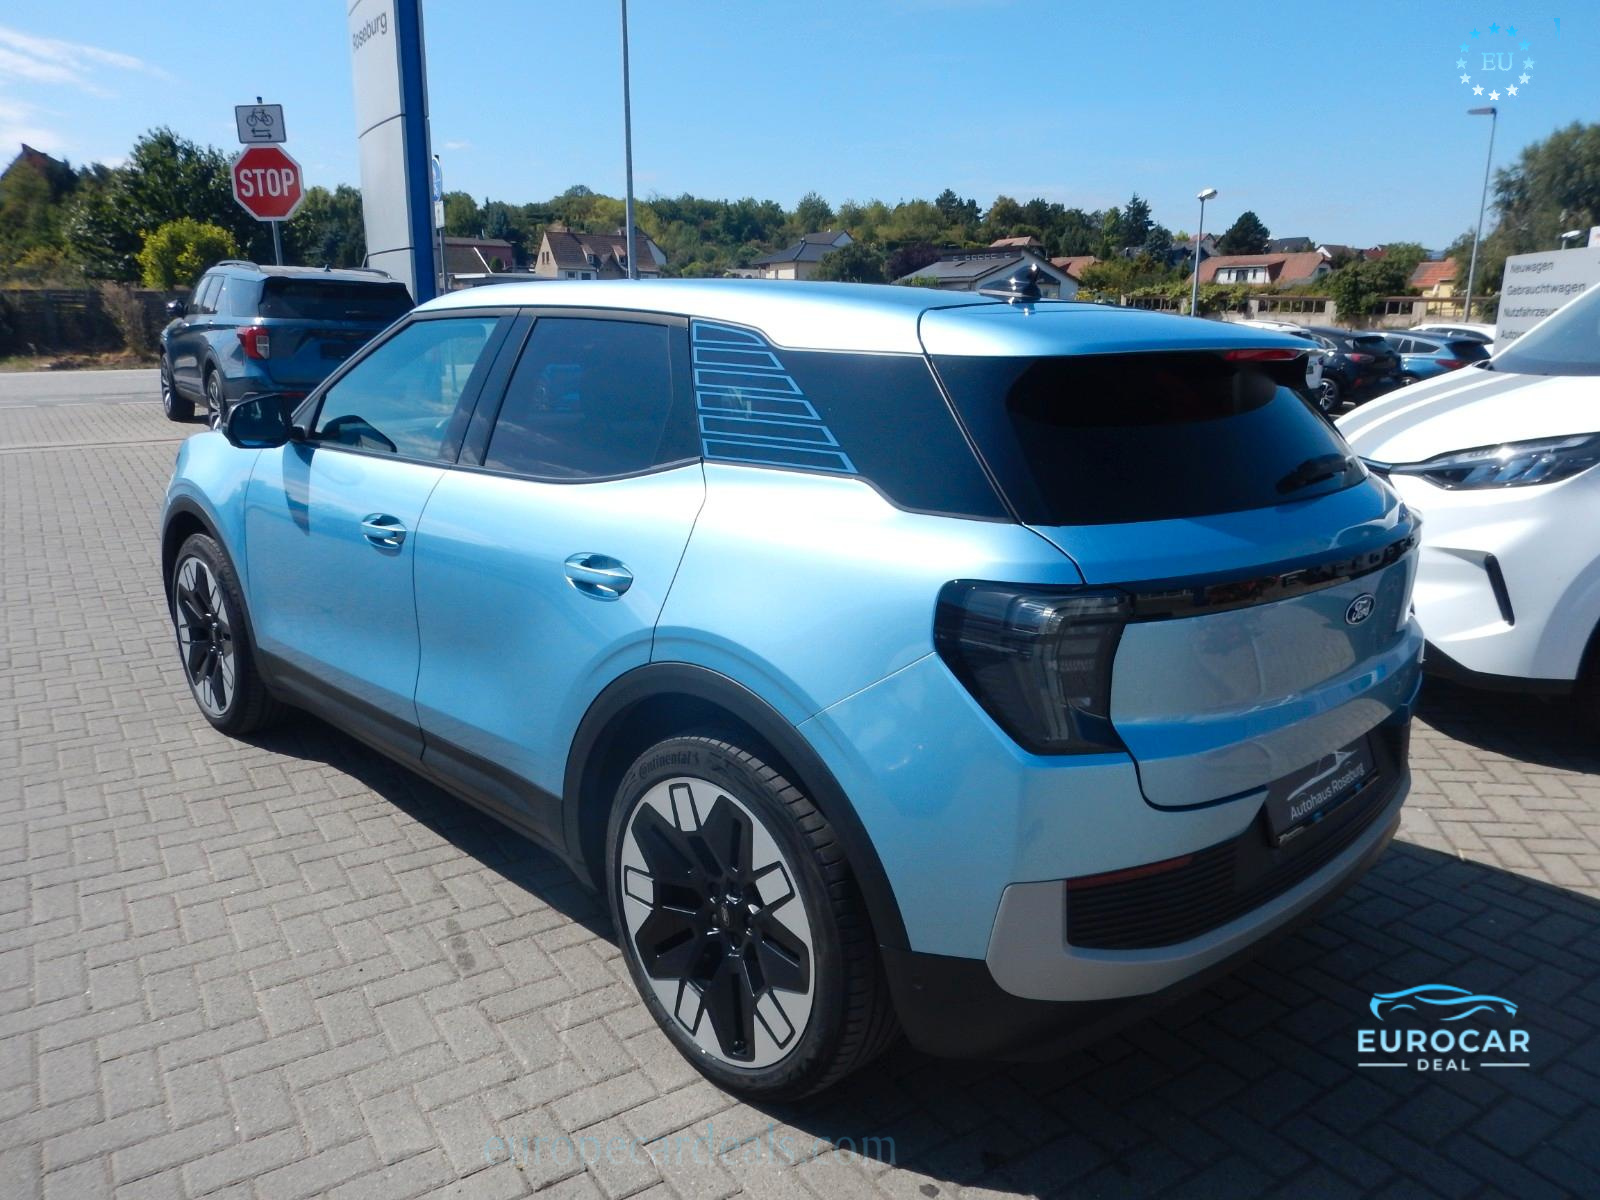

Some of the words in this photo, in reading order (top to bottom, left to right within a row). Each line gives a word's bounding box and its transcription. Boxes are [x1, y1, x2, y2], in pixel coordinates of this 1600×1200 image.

[239, 168, 295, 198] STOP
[1509, 261, 1555, 274] Neuwagen
[1506, 282, 1586, 296] Gebrauchtwagen
[1290, 788, 1332, 821] Autohaus
[1331, 762, 1365, 794] Roseburg
